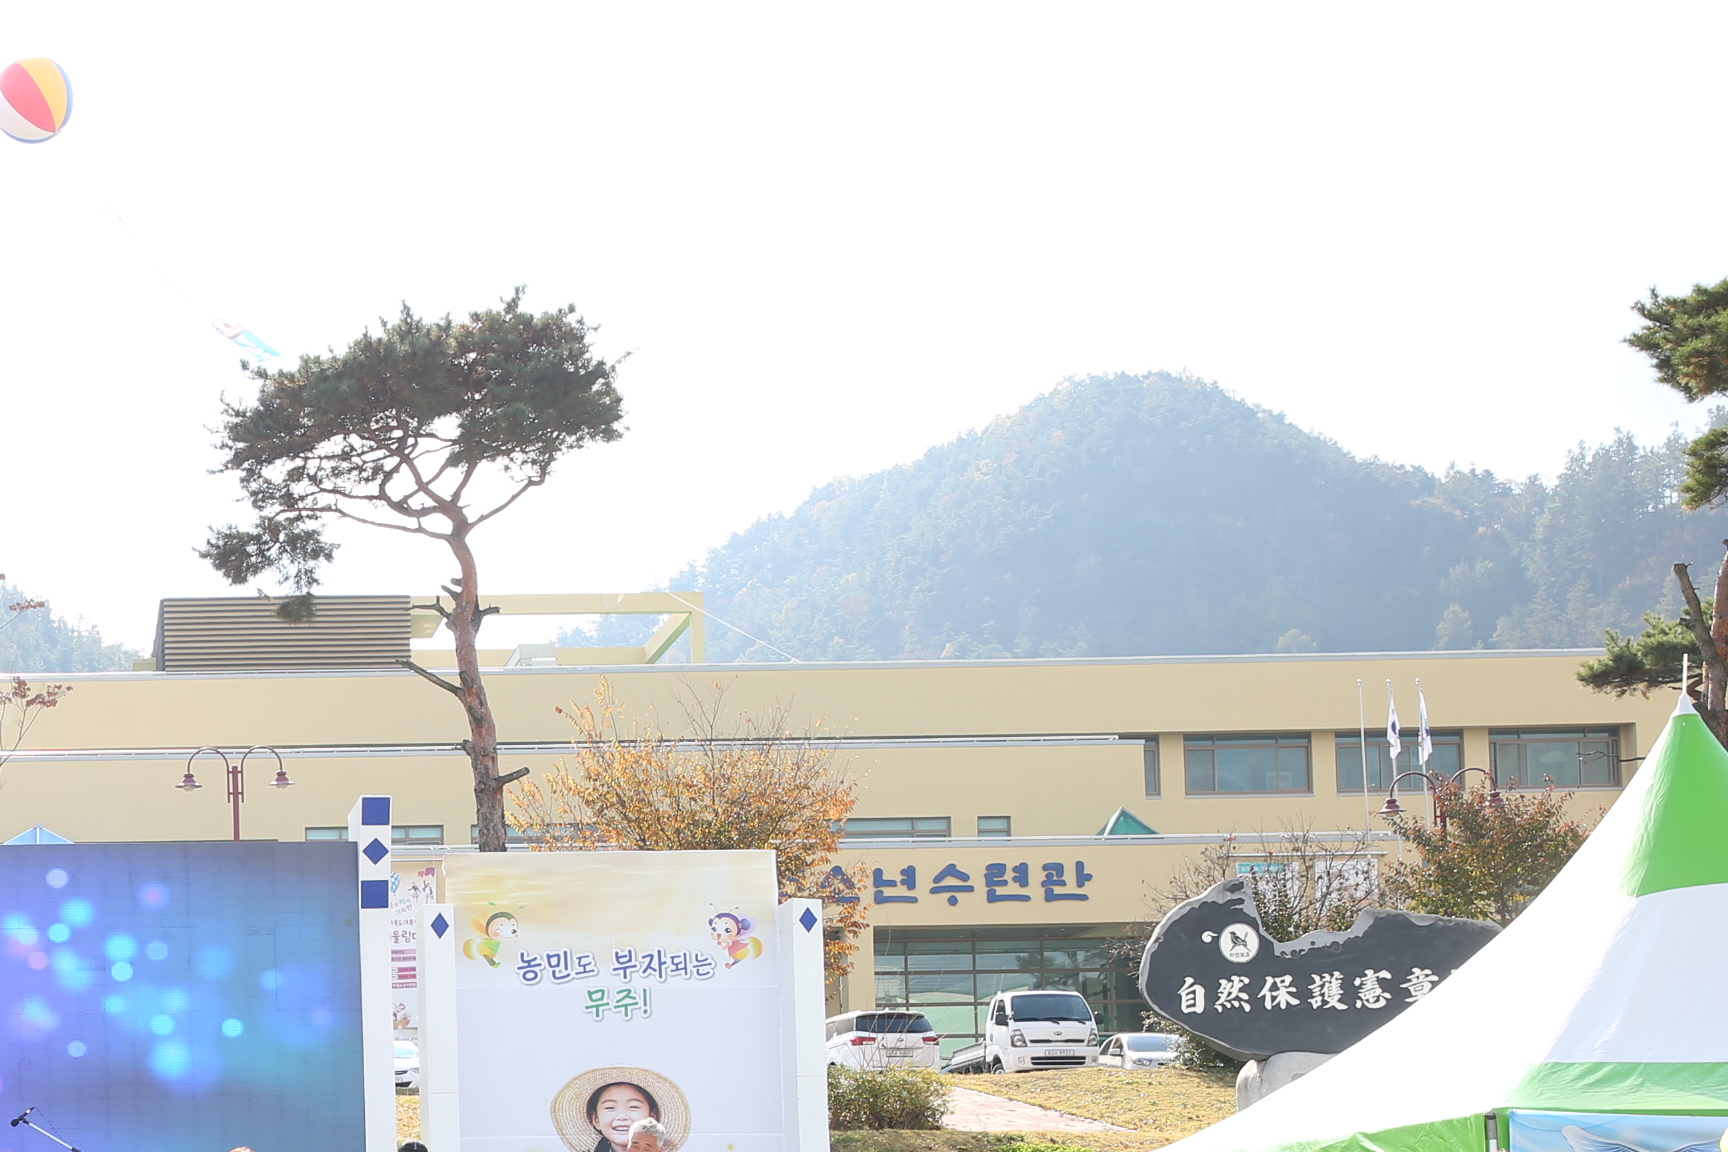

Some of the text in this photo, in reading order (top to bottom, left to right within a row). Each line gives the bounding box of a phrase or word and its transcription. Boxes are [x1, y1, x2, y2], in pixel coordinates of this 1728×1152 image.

[779, 861, 1093, 905] 소년수련관
[517, 949, 713, 982] 농민도 부자되는
[584, 988, 649, 1018] 무주!
[1177, 967, 1439, 1015] 自然保護憲章
